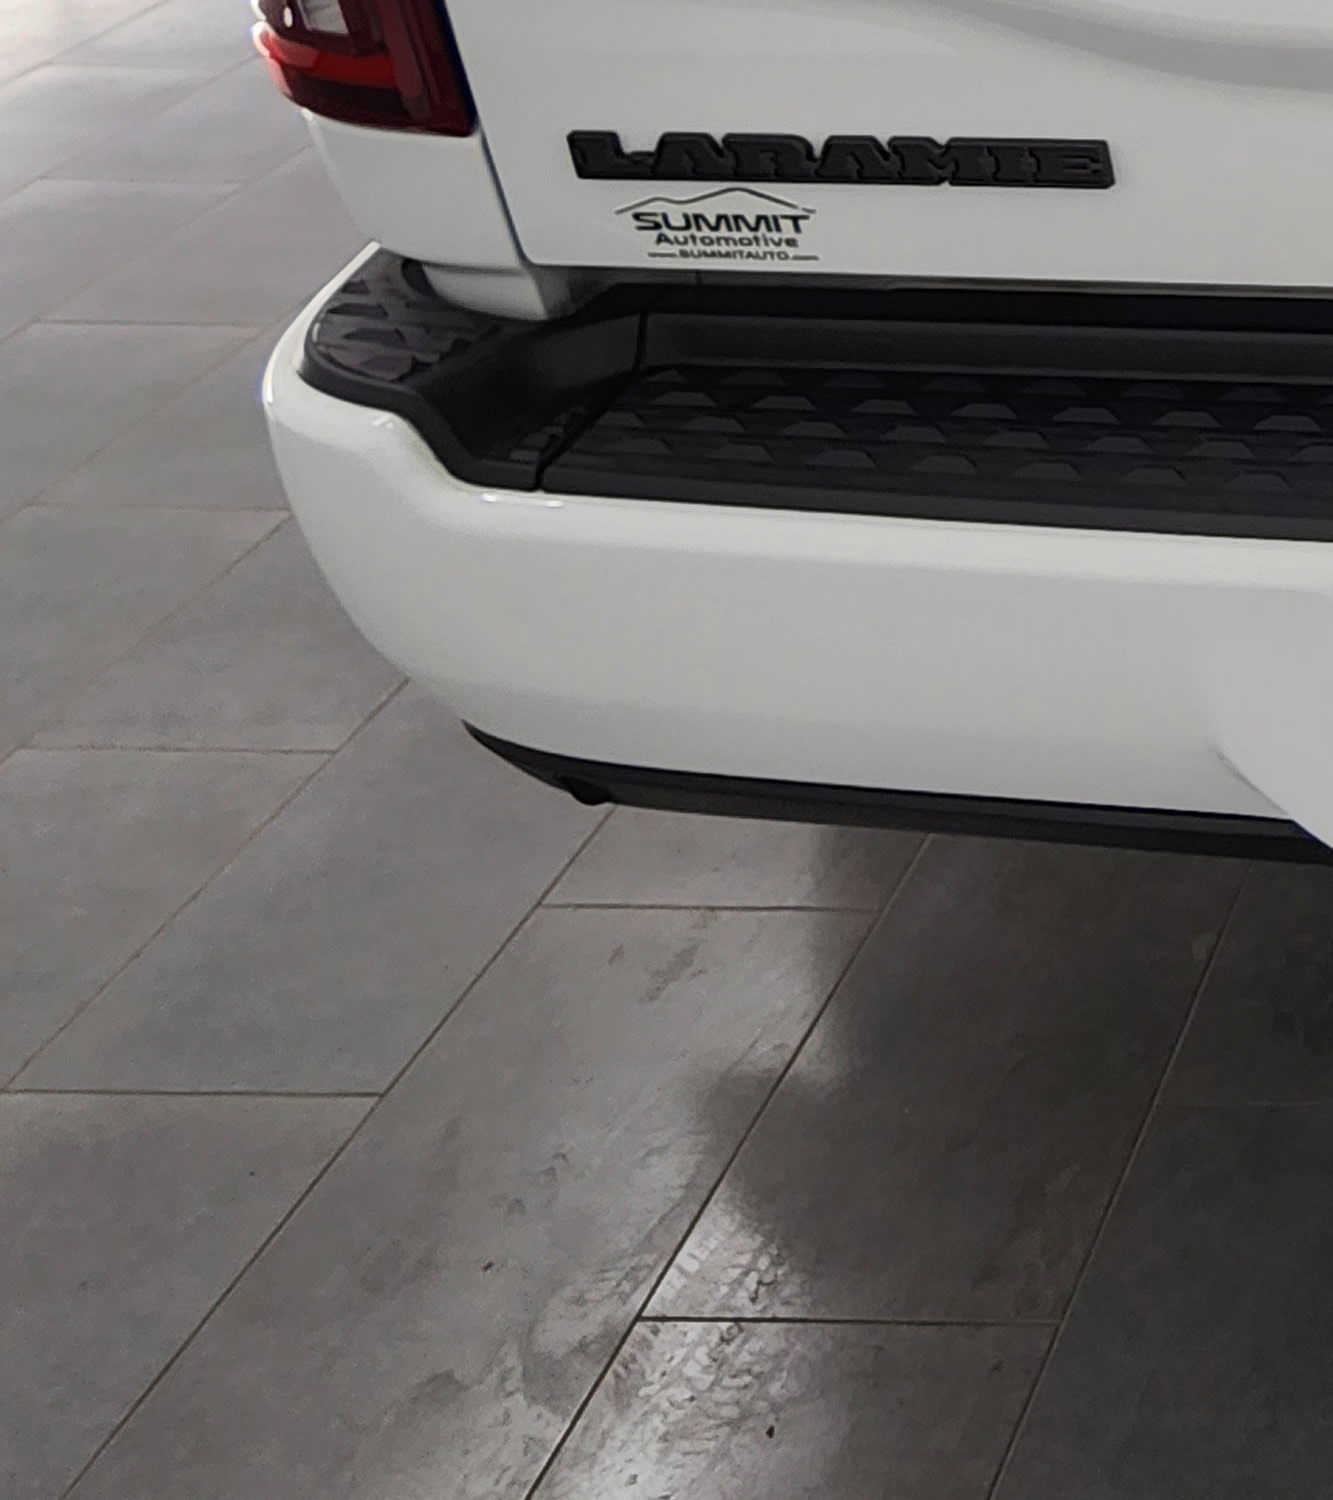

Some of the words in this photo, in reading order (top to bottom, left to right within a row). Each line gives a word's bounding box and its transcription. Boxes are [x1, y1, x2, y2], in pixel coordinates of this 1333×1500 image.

[566, 129, 1116, 189] LARAMIE
[631, 212, 811, 234] SUMMIT
[655, 231, 799, 248] Automotive
